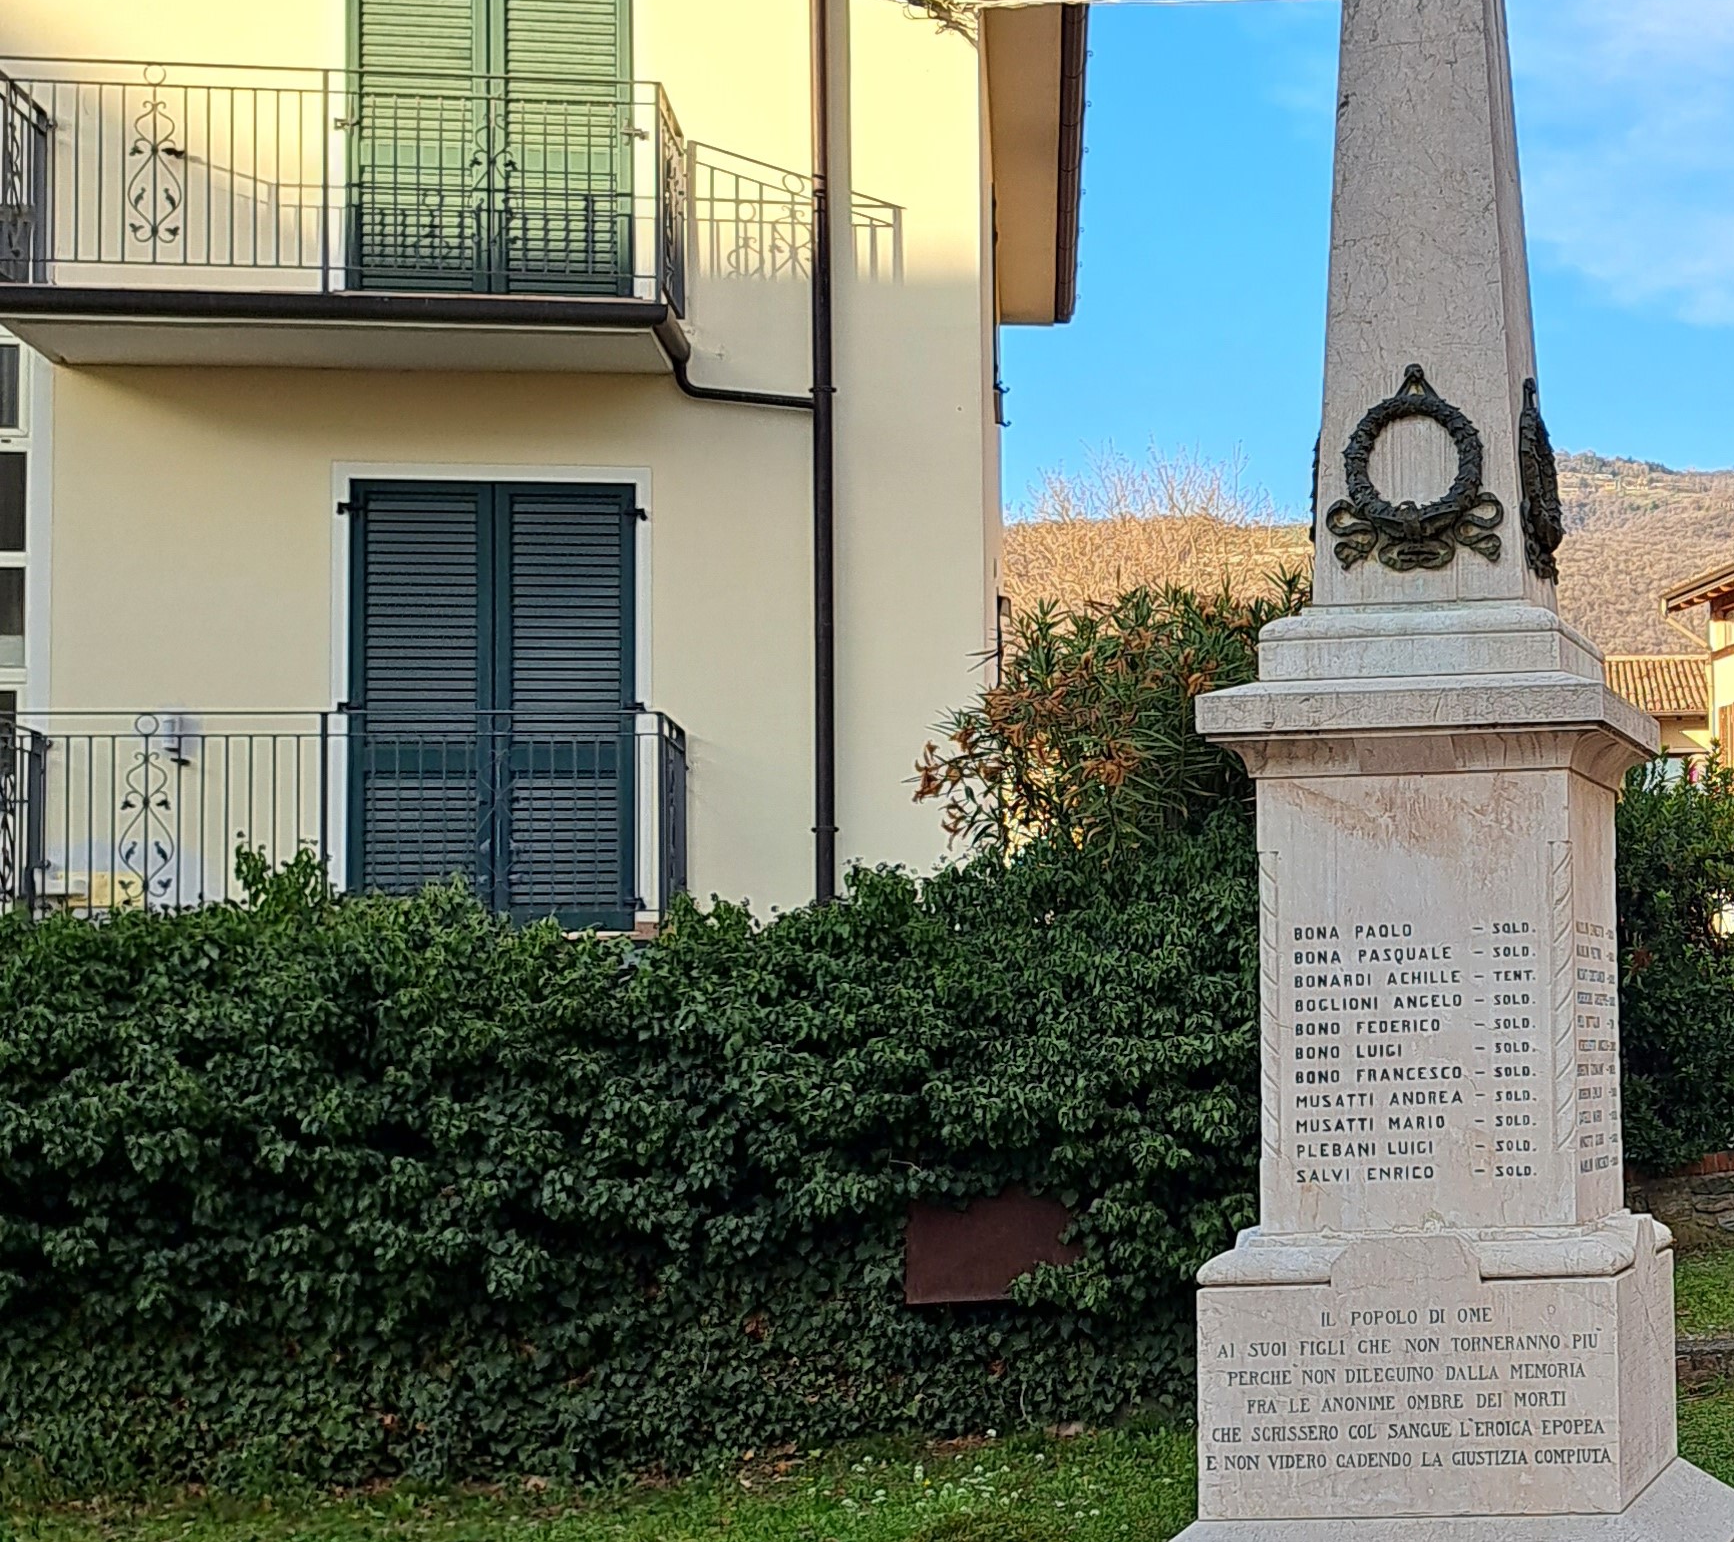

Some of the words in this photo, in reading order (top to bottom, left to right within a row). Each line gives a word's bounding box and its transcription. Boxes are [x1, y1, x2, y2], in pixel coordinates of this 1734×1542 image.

[1294, 926, 1340, 941] BONA
[1355, 924, 1412, 939] PAOLO
[1492, 922, 1536, 934] SOLD.
[1294, 951, 1341, 965] BONA
[1358, 947, 1452, 964] PASQUALE
[1492, 946, 1536, 958] SOLD.
[1294, 973, 1371, 988] BONARDI
[1387, 970, 1461, 986] ACHILLE
[1493, 970, 1536, 981] TENT.
[1295, 997, 1378, 1012] BOGLIONI
[1394, 994, 1462, 1009] ANGELO
[1494, 994, 1536, 1005] SOLD.
[1295, 1022, 1340, 1036] BONO
[1356, 1019, 1440, 1034] FEDERICO
[1494, 1018, 1536, 1029] SOLD.
[1295, 1046, 1340, 1060] BONO
[1356, 1044, 1402, 1058] LUIGI
[1495, 1042, 1536, 1053] SOLD.
[1295, 1070, 1340, 1084] BONO
[1356, 1066, 1462, 1082] FRANCESCO
[1494, 1066, 1536, 1077] SOLD.
[1296, 1093, 1374, 1108] MUSATTI
[1389, 1090, 1463, 1106] ANDREA
[1495, 1090, 1536, 1102] SOLD.
[1296, 1118, 1374, 1133] MUSATTI
[1388, 1116, 1445, 1130] MARIO
[1495, 1115, 1536, 1127] SOLD.
[1296, 1142, 1375, 1158] PLEBANI
[1388, 1141, 1433, 1155] LUIGI
[1495, 1140, 1536, 1151] SOLD.
[1296, 1169, 1349, 1183] SALVI
[1367, 1166, 1433, 1180] ENRICO
[1495, 1166, 1537, 1177] SOLD.
[1321, 1312, 1336, 1327] IL
[1351, 1310, 1418, 1326] POPOLO
[1429, 1309, 1446, 1324] DI
[1457, 1308, 1492, 1323] OME
[1217, 1343, 1235, 1358] AI
[1248, 1342, 1287, 1357] SUOI
[1300, 1340, 1345, 1356] FIGLI
[1357, 1339, 1391, 1354] CHE
[1406, 1338, 1440, 1352] NON
[1451, 1335, 1560, 1352] TORNERANNO
[1302, 1368, 1336, 1385] NON
[1345, 1366, 1433, 1384] DILEGUINO
[1445, 1365, 1499, 1381] DALLA
[1510, 1363, 1586, 1379] MEMORIA
[1247, 1399, 1277, 1414] FRA
[1288, 1398, 1310, 1413] LE
[1321, 1396, 1395, 1413] ANONIME
[1407, 1394, 1463, 1410] OMBRE
[1476, 1393, 1502, 1408] DEI
[1514, 1390, 1566, 1407] MORTI
[1212, 1427, 1242, 1443] CHE
[1251, 1425, 1338, 1442] SCRISSERO
[1349, 1424, 1377, 1440] COL
[1388, 1422, 1451, 1440] SANGUE
[1542, 1419, 1605, 1435] EPOPEA
[1206, 1455, 1217, 1471] E
[1225, 1455, 1260, 1470] NON
[1267, 1454, 1327, 1469] VIDERO
[1336, 1452, 1411, 1469] CADENDO
[1421, 1452, 1443, 1467] LA
[1452, 1450, 1528, 1466] GIUSTIZIA
[1534, 1448, 1611, 1464] COMPIUTA
